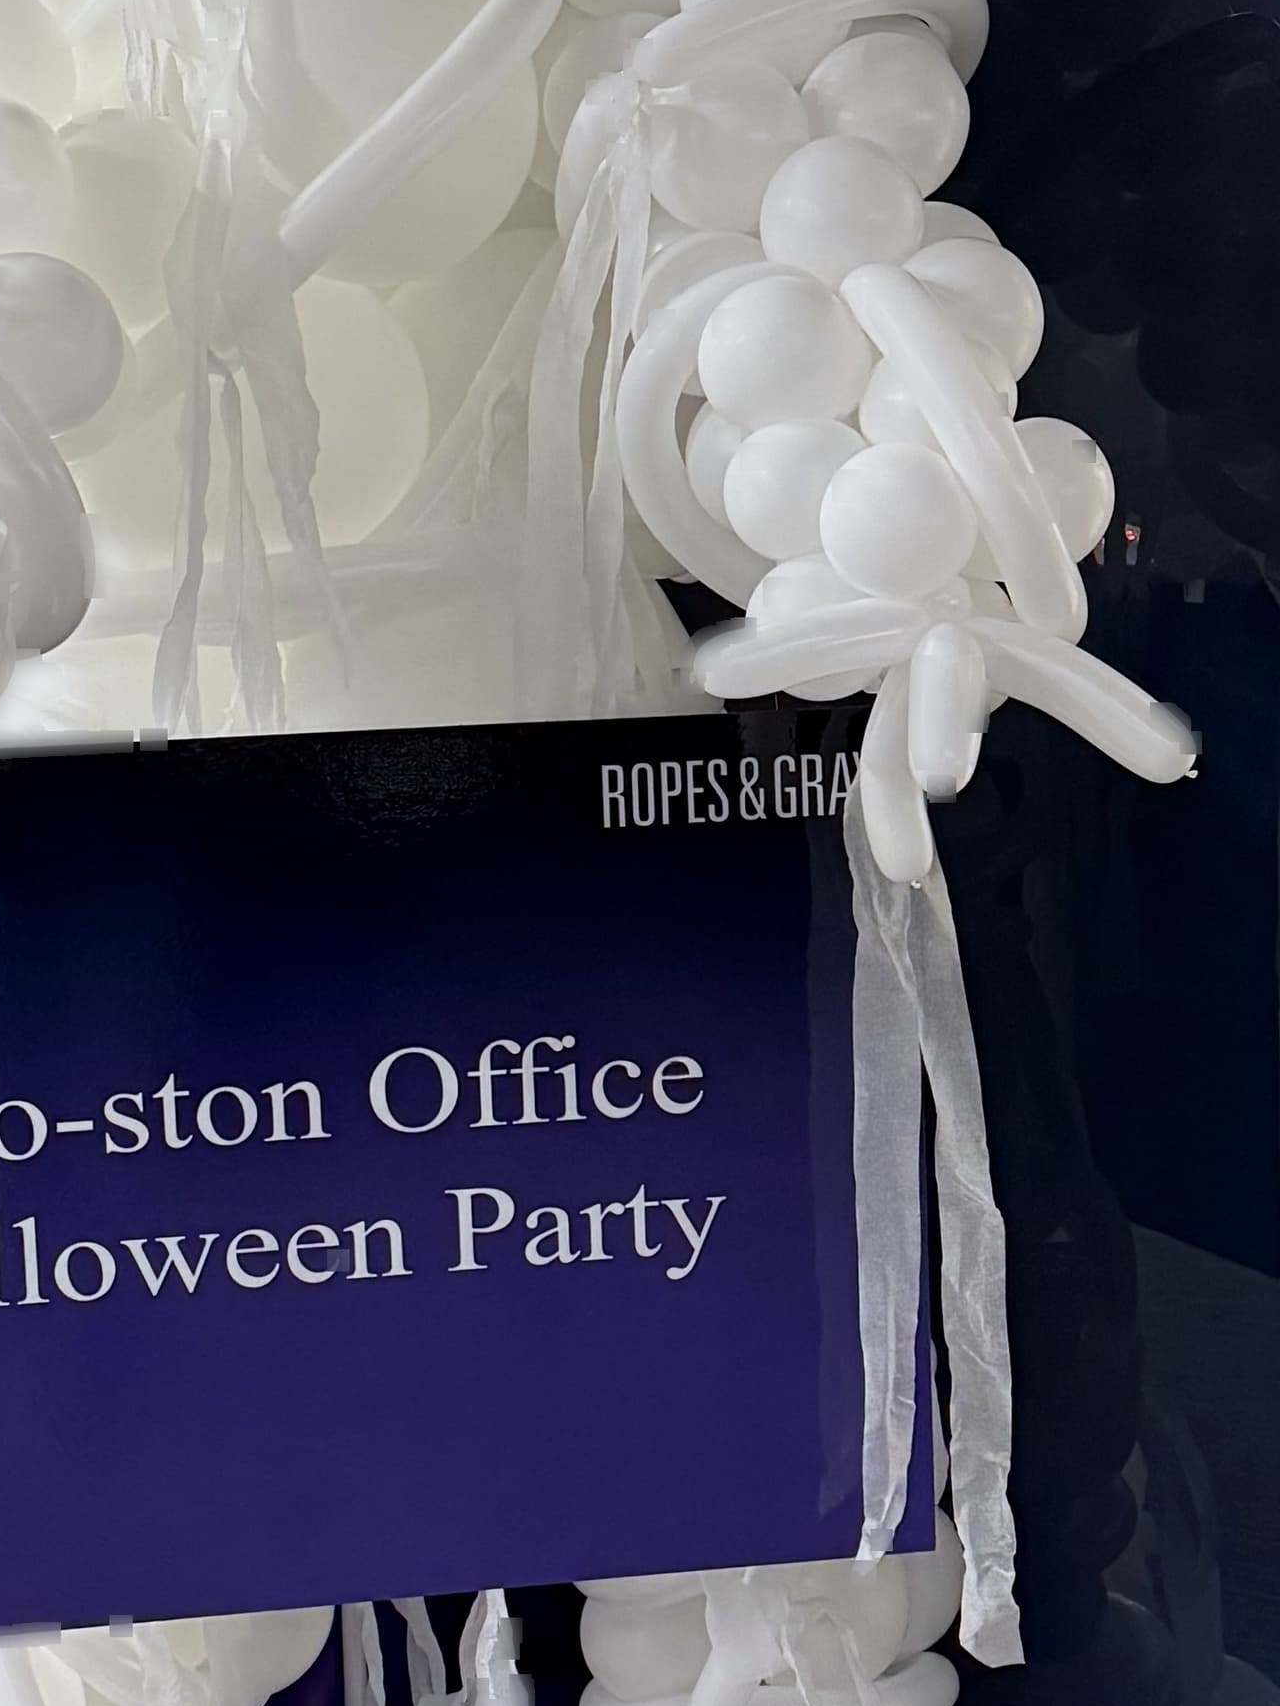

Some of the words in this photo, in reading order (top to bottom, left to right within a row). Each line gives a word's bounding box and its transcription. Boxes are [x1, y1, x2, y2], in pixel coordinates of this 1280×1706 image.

[601, 759, 729, 828] ROPES
[773, 750, 861, 820] GRA
[366, 1033, 707, 1135] Office
[444, 1182, 727, 1281] Party
